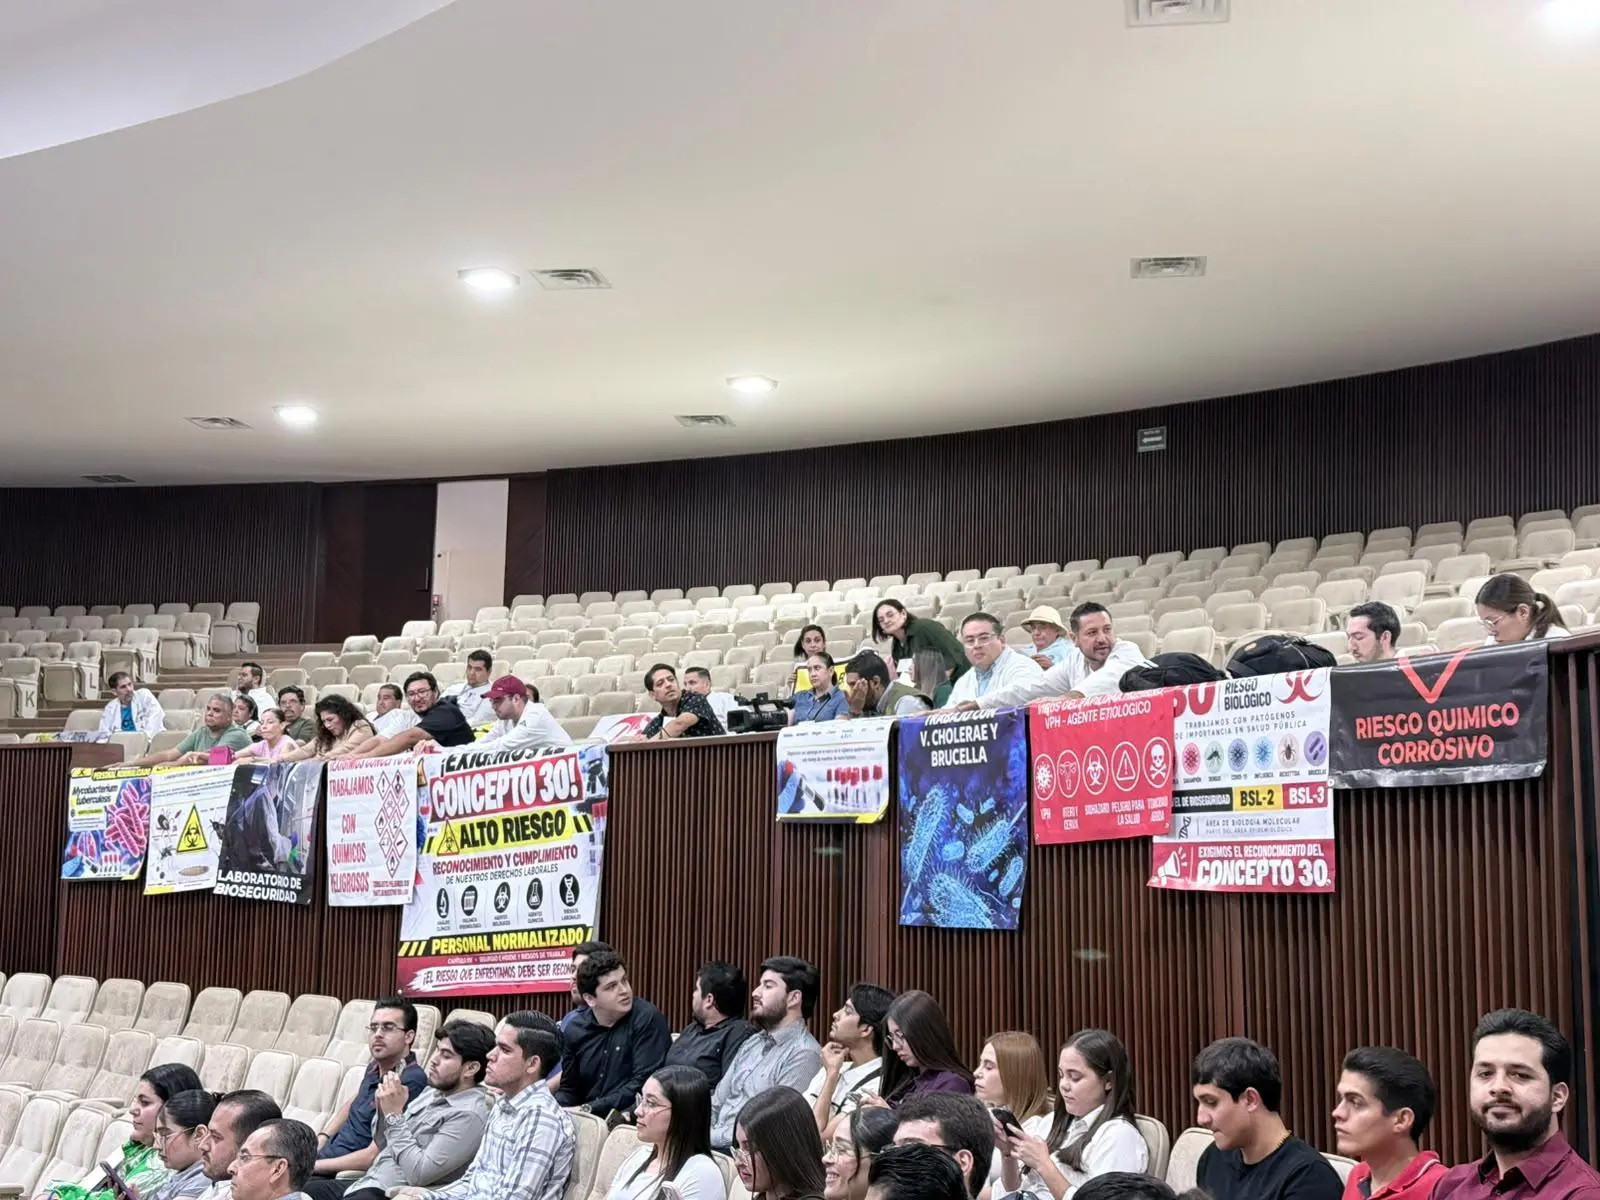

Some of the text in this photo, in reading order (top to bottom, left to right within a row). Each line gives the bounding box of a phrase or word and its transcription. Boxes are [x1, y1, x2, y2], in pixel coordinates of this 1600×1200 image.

[199, 642, 208, 657] N
[145, 657, 156, 673] M
[89, 672, 97, 689] L
[1224, 677, 1258, 695] RIESGO
[25, 691, 35, 707] K
[1224, 691, 1272, 711] BIOLOGICO
[1045, 714, 1061, 729] VPH
[1067, 708, 1099, 725] AGENTE
[1100, 700, 1152, 721] ETIOLOGICO
[1185, 710, 1296, 729] TRABAJAMOS CON PATÓGENOS
[1356, 702, 1520, 739] RIESGO QUIMICO
[919, 722, 998, 747] V. CHOLERAE Y
[1186, 725, 1232, 739] IMPORTANCIA
[1235, 725, 1245, 735] EN
[1247, 722, 1270, 733] SALUD
[1273, 719, 1307, 730] PÚBLICA
[931, 745, 988, 767] BRUCELLA
[1377, 735, 1495, 766] CORROSIVO
[72, 784, 118, 796] Mycobacterium
[329, 775, 374, 798] TRABAJAMOS
[431, 757, 579, 818] CONCEPTO 30!
[1288, 785, 1325, 805] BSL-3
[1189, 793, 1231, 807] BIOSEGURIDAD
[1240, 789, 1275, 807] BSL-2
[341, 814, 356, 835] CON
[460, 809, 566, 849] ALTO RIESGO
[1262, 816, 1300, 826] MOLECULAR
[432, 844, 578, 876] RECONOCIMIENTO Y CUMPLIMIENTO
[1198, 843, 1324, 858] EXIGIMOS EL RECONOCIMIENTO DEL
[217, 869, 289, 888] LABORATORIO
[290, 877, 302, 890] DE
[446, 863, 559, 885] DE NUESTROS DERECHOS LABORALES
[1197, 858, 1296, 887] CONCEPTO
[213, 882, 297, 903] BIOSEGURIDAD
[431, 926, 584, 955] PERSONAL NORMALIZADO
[423, 970, 434, 985] ¡EL
[435, 968, 459, 982] RIESGO
[460, 967, 473, 981] QUE
[474, 965, 516, 980] ENFRENTAMOS
[517, 964, 536, 978] DEBE
[537, 963, 551, 977] SER
